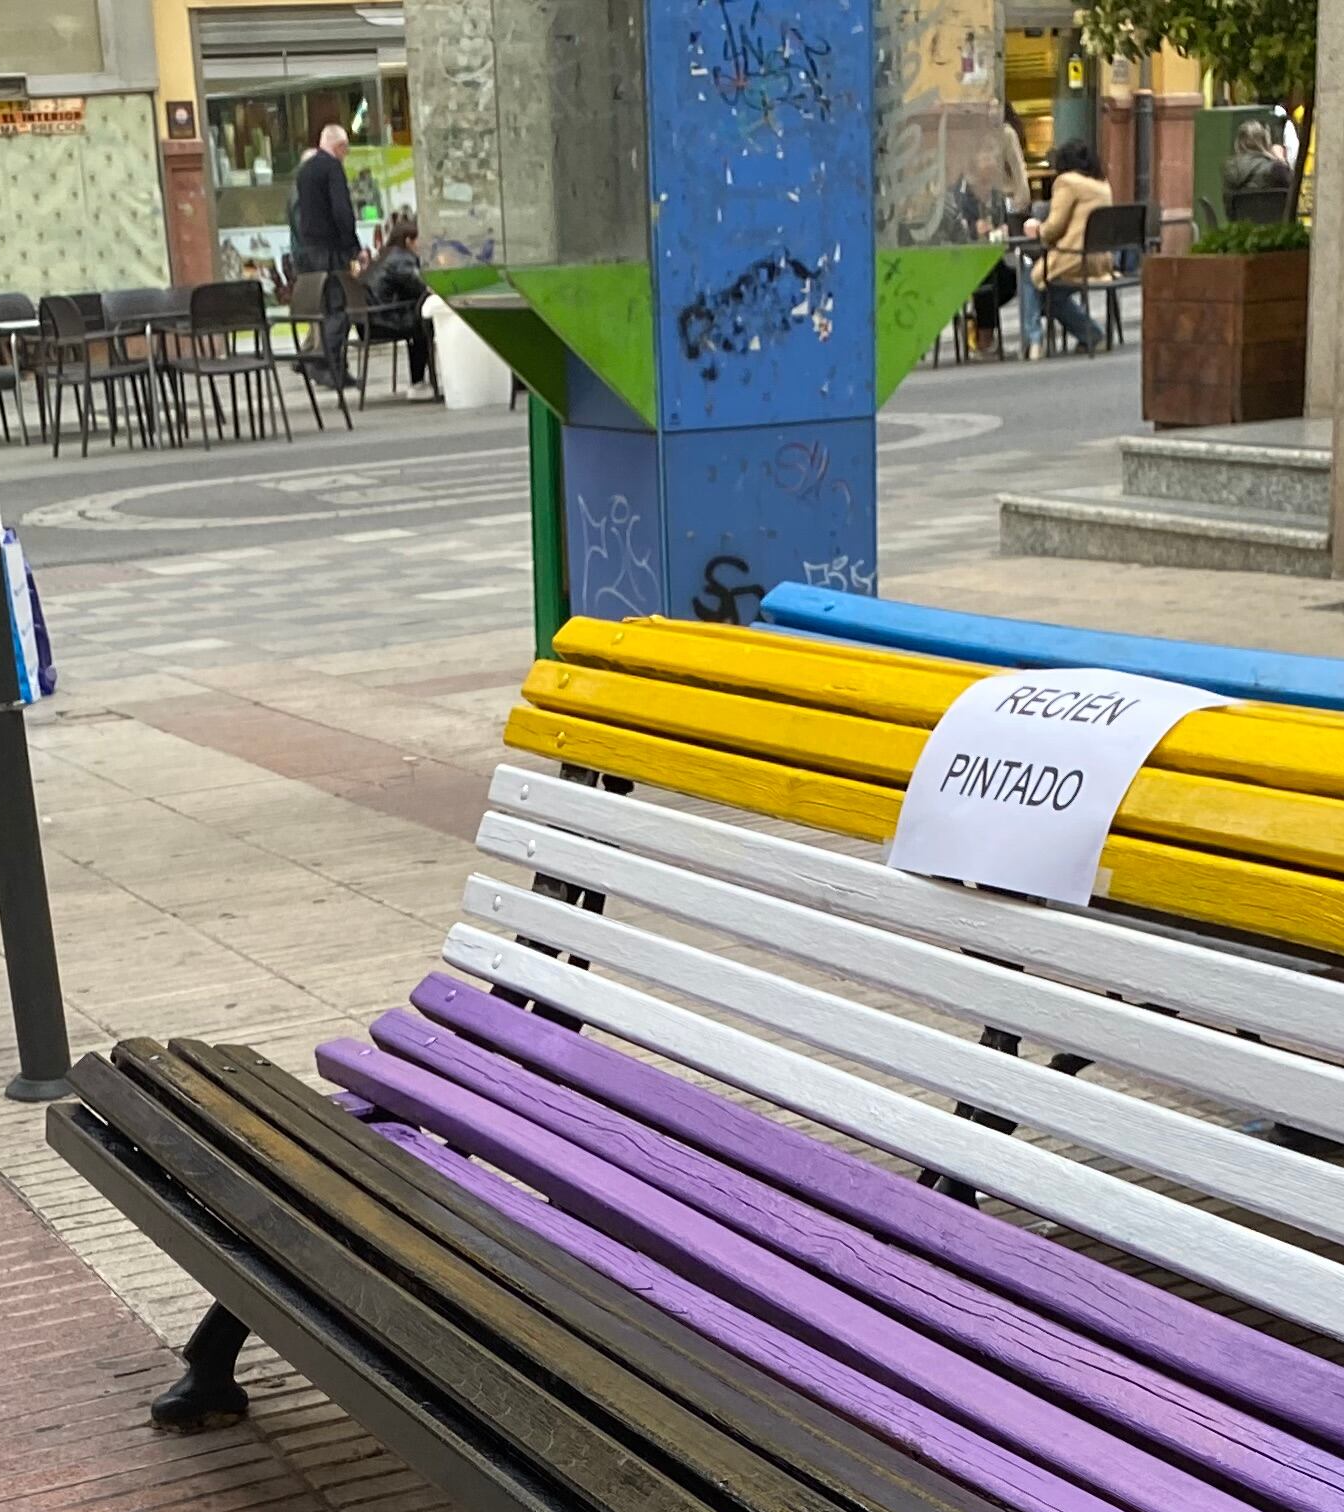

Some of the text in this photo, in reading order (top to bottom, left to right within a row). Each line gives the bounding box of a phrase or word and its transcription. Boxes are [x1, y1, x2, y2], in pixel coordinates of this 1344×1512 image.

[2, 113, 16, 123] EL
[22, 110, 82, 122] INTERIOR
[995, 686, 1141, 727] RECIÉN
[939, 753, 1084, 812] PINTADO
